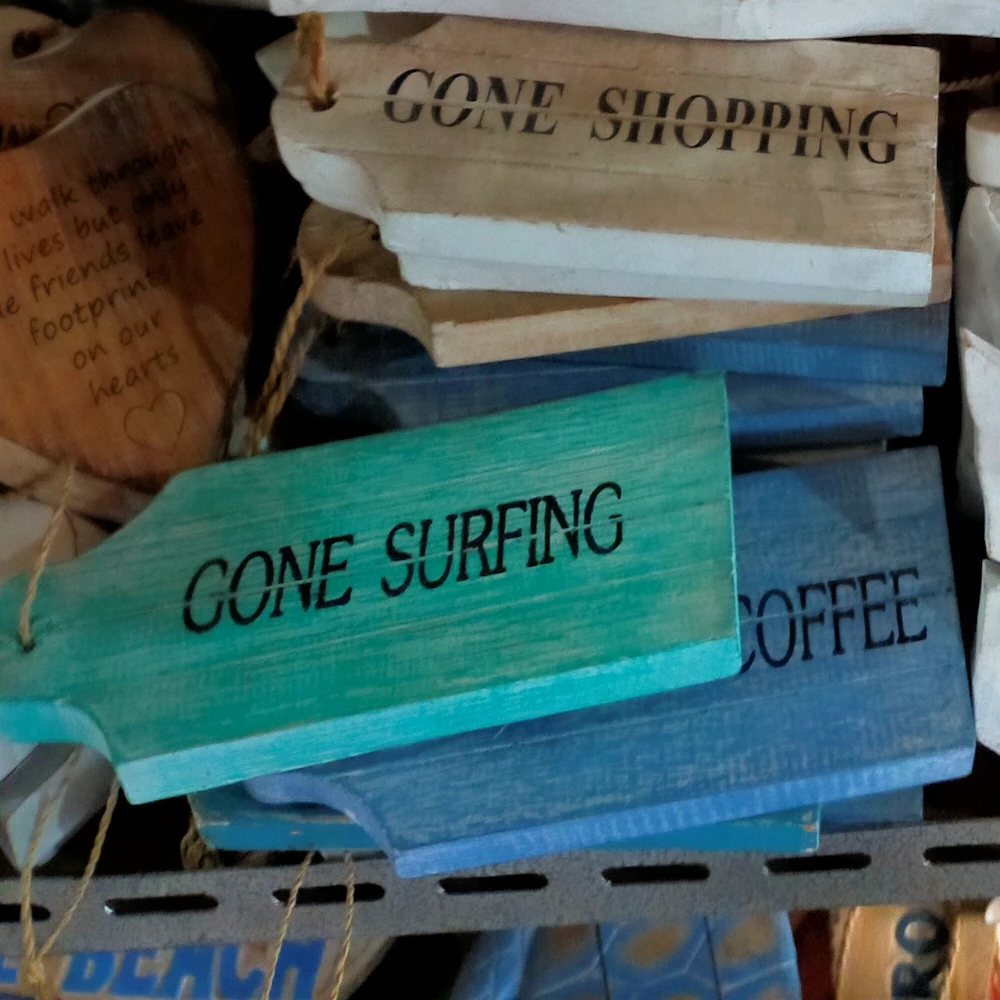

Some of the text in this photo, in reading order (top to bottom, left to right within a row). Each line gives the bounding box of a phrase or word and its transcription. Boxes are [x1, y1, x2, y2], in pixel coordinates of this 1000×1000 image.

[384, 69, 898, 164] GONE SHOPPING
[10, 184, 78, 228] walk
[2, 232, 64, 273] lives
[73, 204, 121, 239] but
[29, 241, 131, 302] friends
[73, 308, 161, 371] on our
[89, 343, 180, 405] hearts
[183, 482, 623, 634] GONE SURFING
